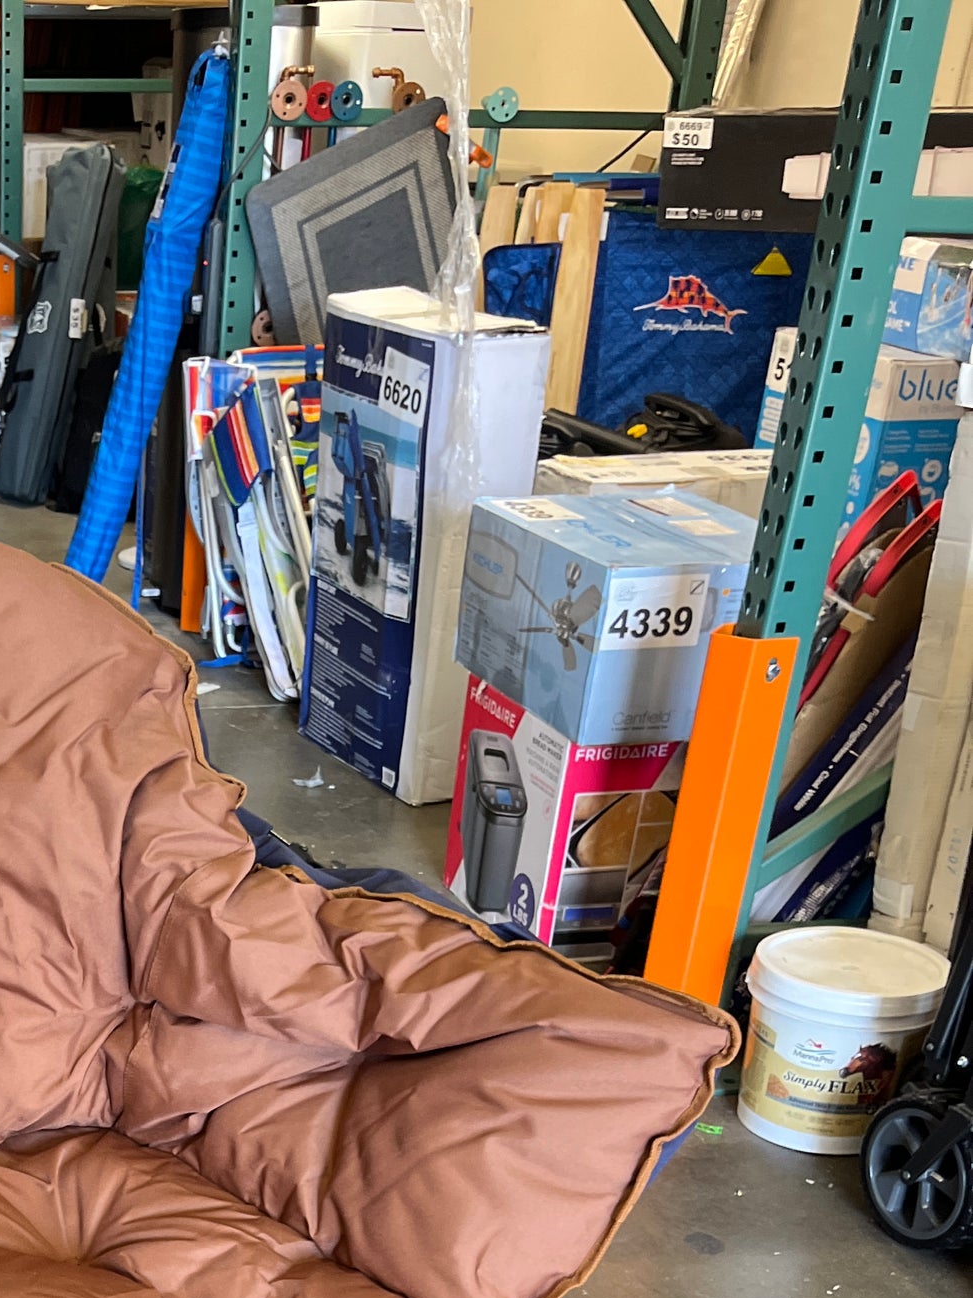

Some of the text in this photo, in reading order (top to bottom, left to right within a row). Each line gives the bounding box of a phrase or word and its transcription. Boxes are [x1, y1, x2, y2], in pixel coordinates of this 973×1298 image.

[672, 133, 699, 146] $50
[642, 319, 680, 335] Tommy
[362, 353, 384, 377] Bah
[383, 375, 422, 414] 6620
[899, 369, 959, 401] blue
[607, 605, 694, 640] 4339
[469, 686, 517, 729] FRIGIDAIRE
[574, 742, 670, 763] FRIGIDAIRE
[517, 883, 529, 910] 2
[512, 903, 528, 927] LBS
[783, 1070, 877, 1095] Simply FLAX
